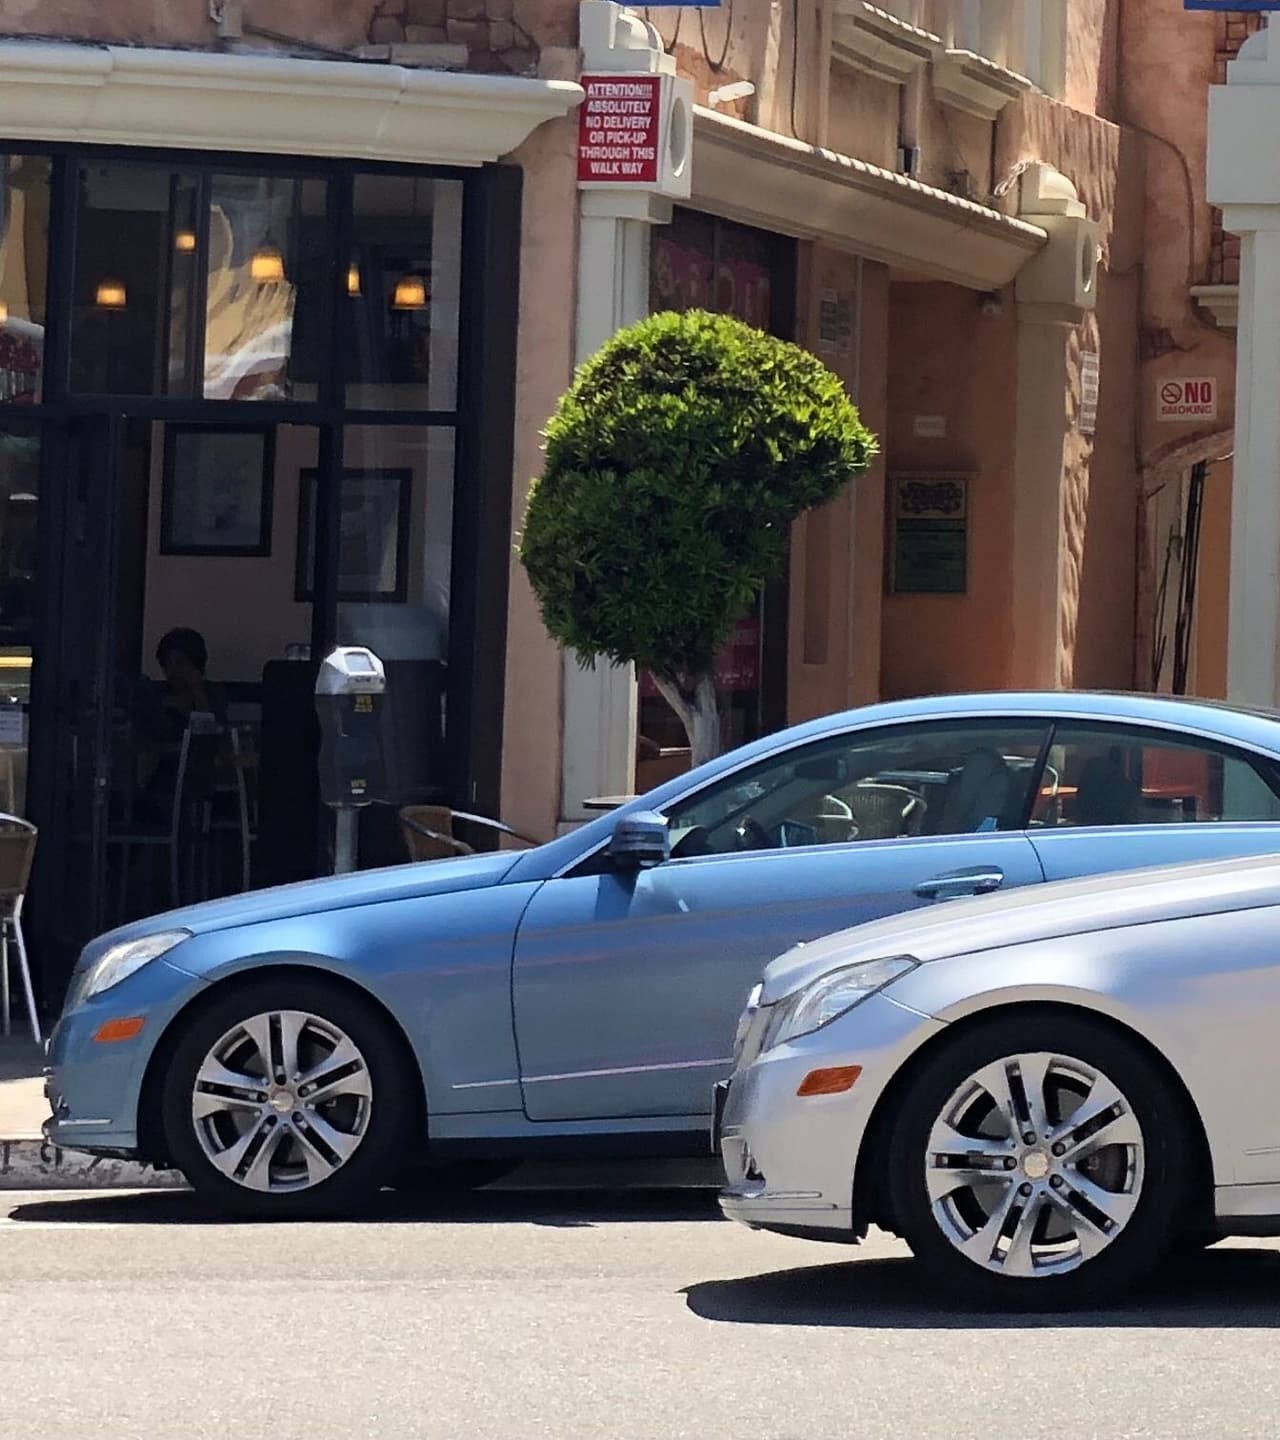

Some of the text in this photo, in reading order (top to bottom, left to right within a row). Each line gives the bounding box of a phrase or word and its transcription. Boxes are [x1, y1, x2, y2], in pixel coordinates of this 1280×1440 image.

[587, 101, 651, 113] ABSOLUTELY
[585, 116, 651, 128] NO DELIVERY
[589, 131, 647, 143] OR PICK-UP
[580, 146, 655, 159] THROUGH THIS
[590, 161, 643, 174] WALK WAY
[1184, 382, 1212, 403] NO
